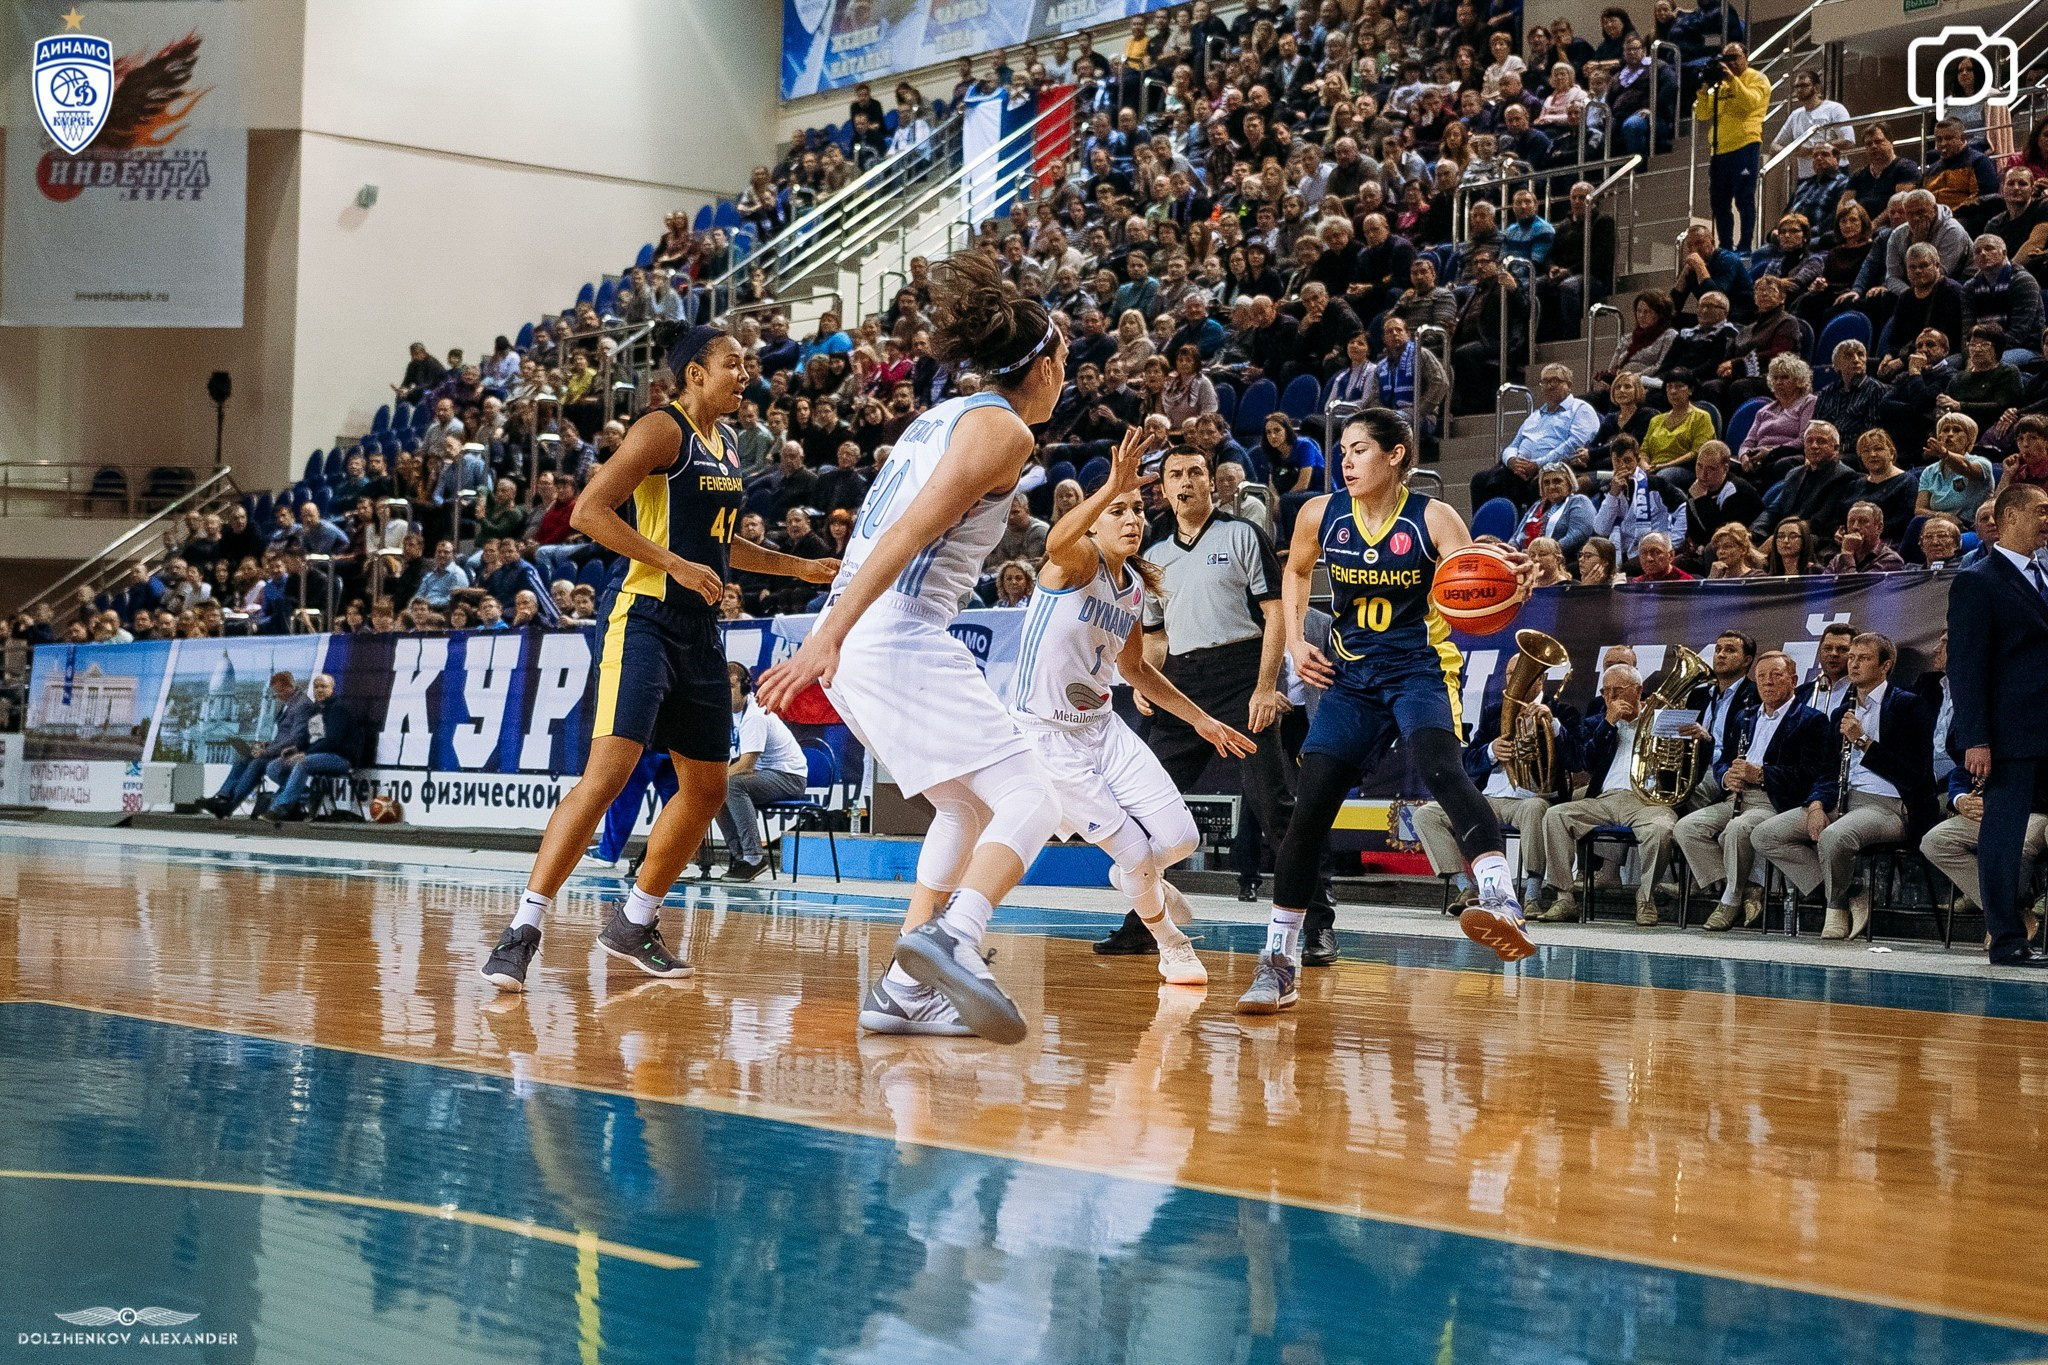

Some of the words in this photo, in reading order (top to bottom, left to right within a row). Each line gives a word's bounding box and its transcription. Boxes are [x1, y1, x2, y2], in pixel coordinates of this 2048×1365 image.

[699, 475, 743, 492] FENERBAH
[710, 507, 738, 544] 41
[1330, 563, 1422, 589] FENERBAHÇE
[1443, 587, 1497, 601] molten
[1353, 597, 1393, 633] 10
[1090, 644, 1106, 676] 1
[376, 633, 592, 769] КУР
[30, 762, 89, 781] КУЛЬТУРНОЙ
[29, 784, 91, 804] ОЛИМПИАДЫ
[390, 779, 412, 804] по
[421, 769, 560, 813] физической
